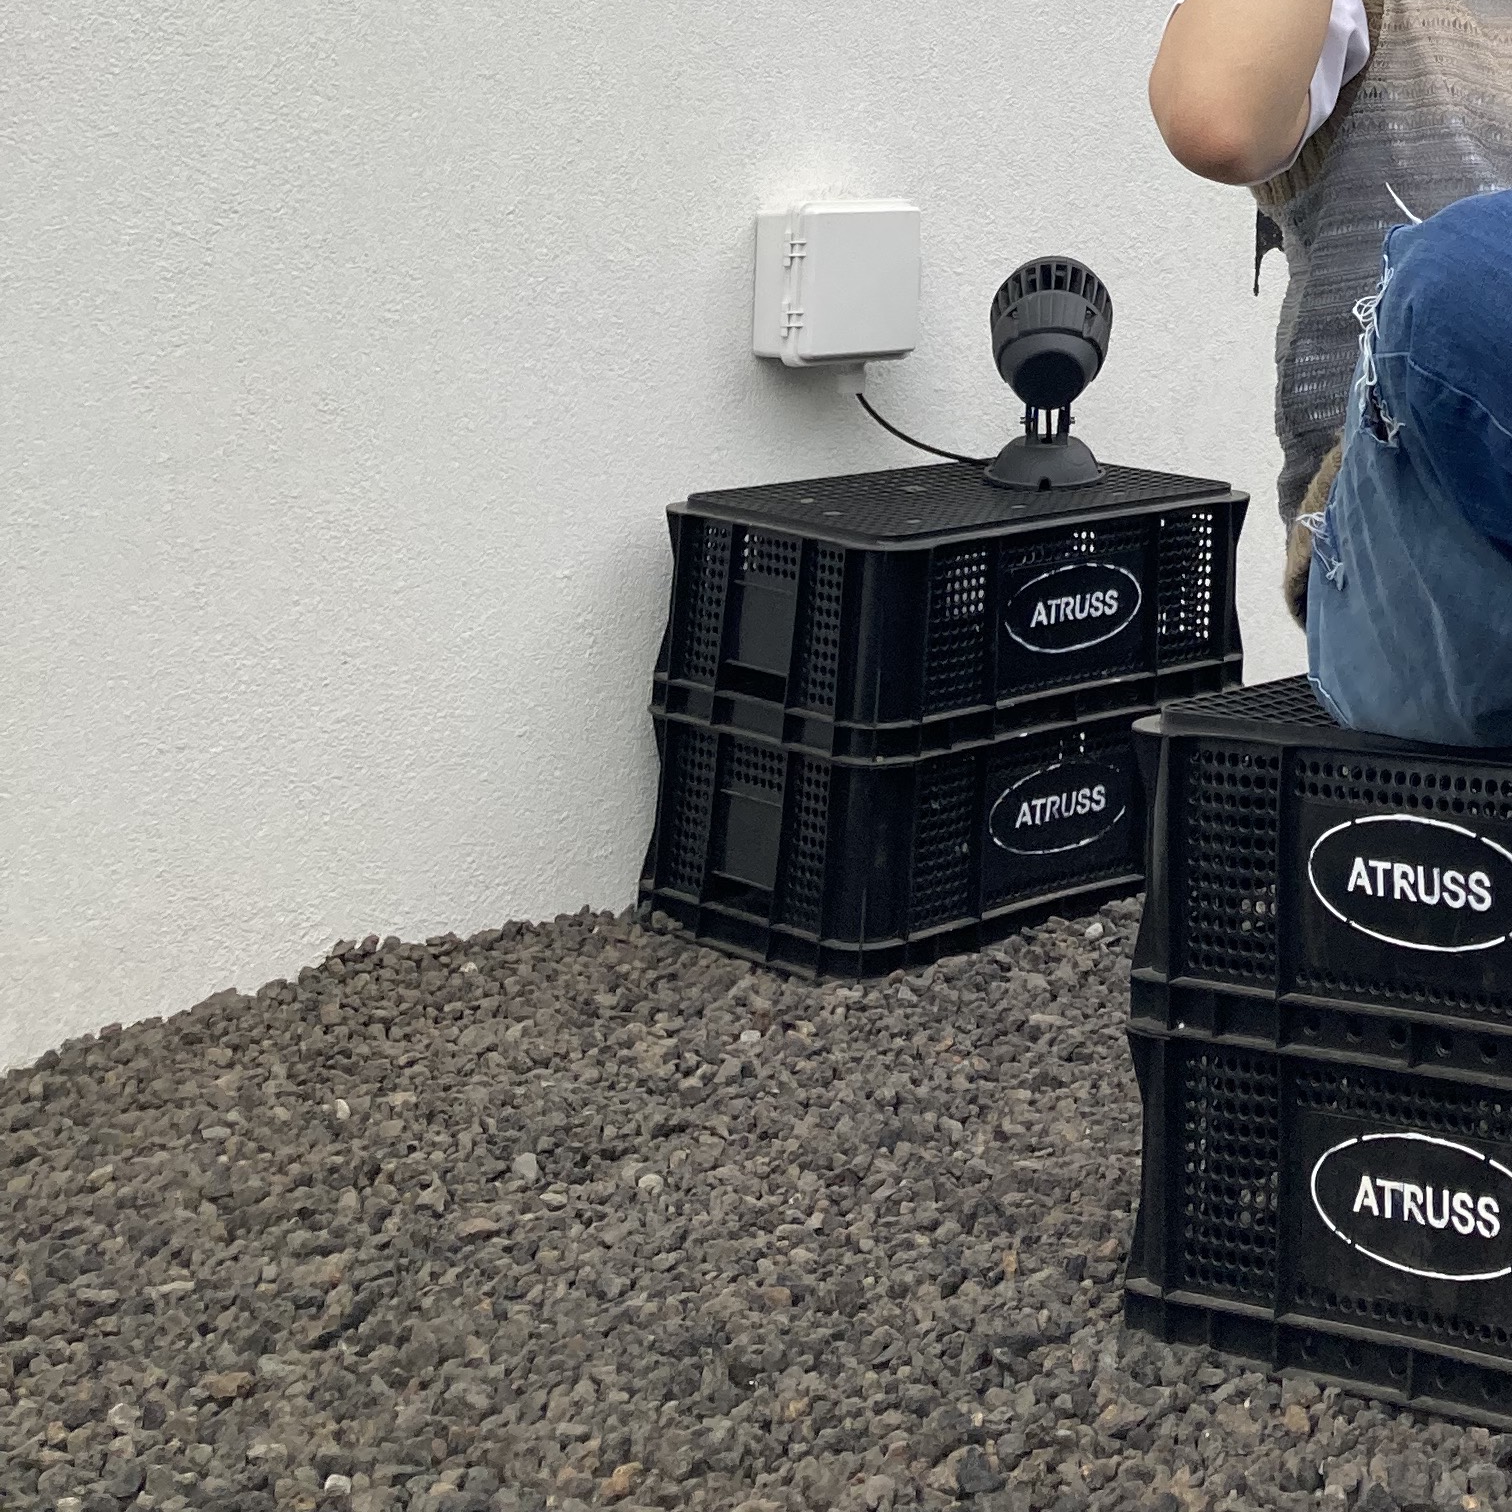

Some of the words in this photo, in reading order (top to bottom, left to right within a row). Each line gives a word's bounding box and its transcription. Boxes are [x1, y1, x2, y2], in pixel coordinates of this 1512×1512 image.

[1030, 590, 1119, 627] ATRUSS
[1015, 785, 1106, 828] ATRUSS
[1347, 857, 1492, 911] ATRUSS
[1353, 1175, 1501, 1238] ATRUSS
